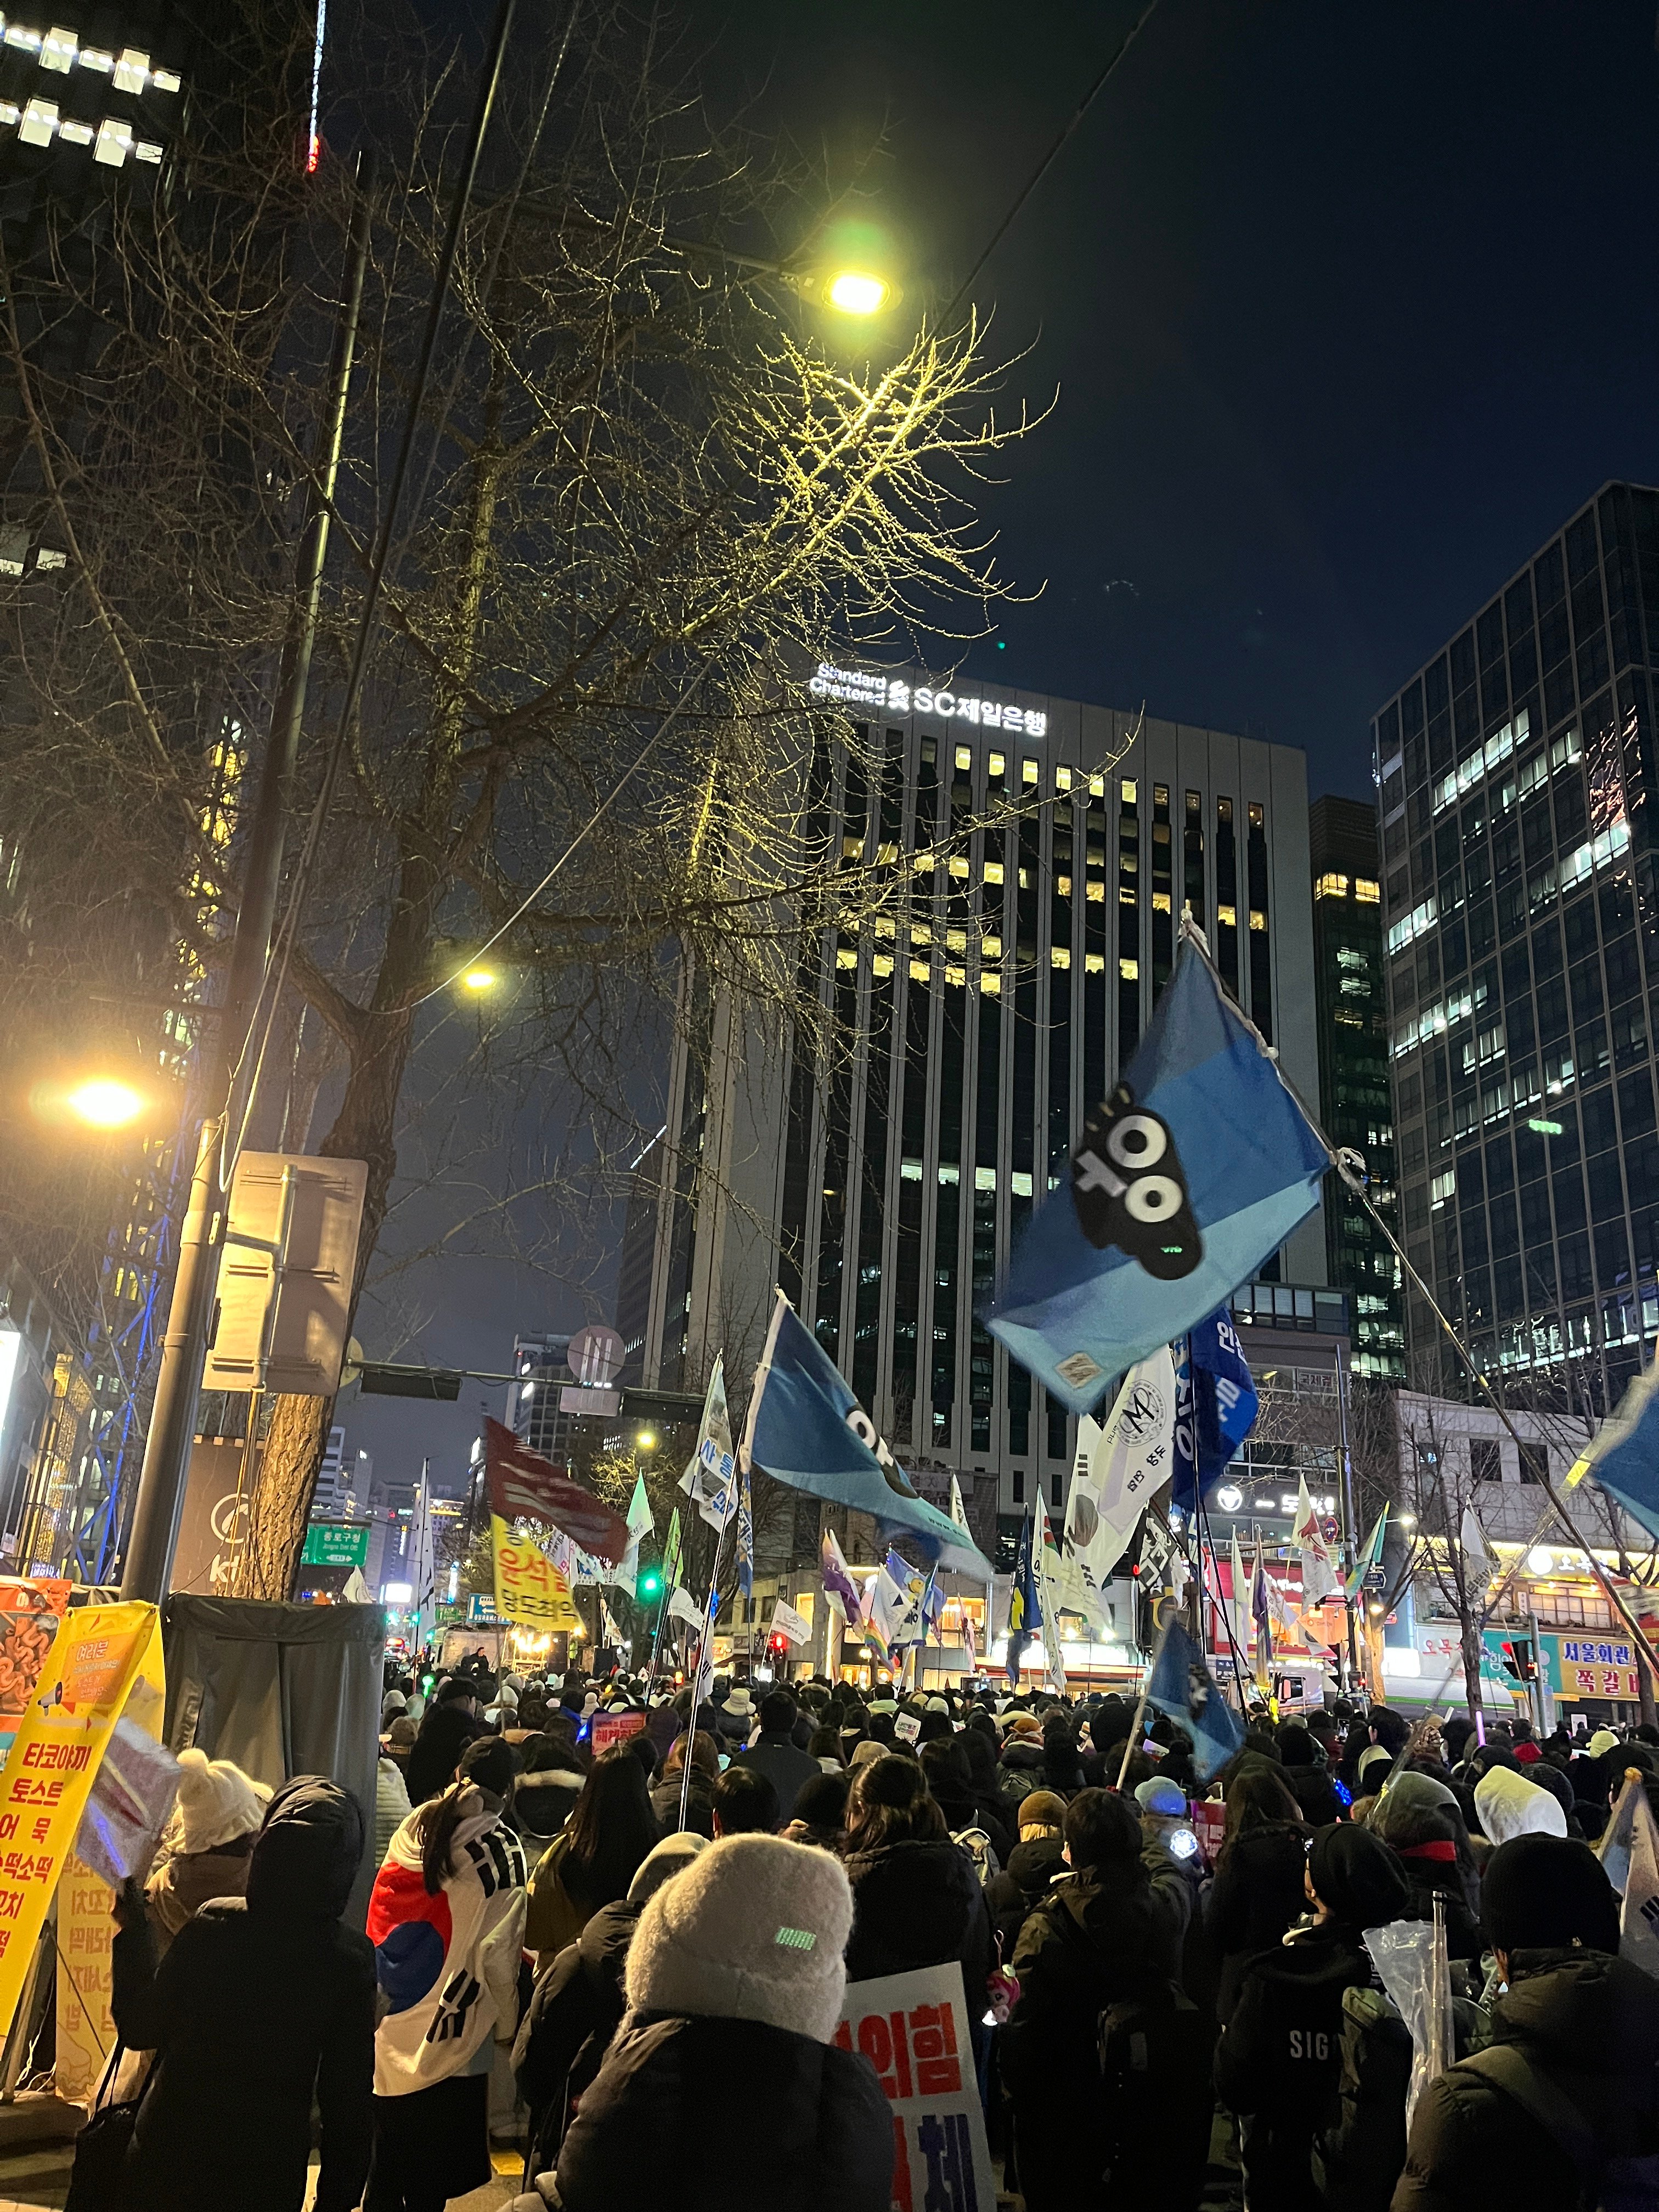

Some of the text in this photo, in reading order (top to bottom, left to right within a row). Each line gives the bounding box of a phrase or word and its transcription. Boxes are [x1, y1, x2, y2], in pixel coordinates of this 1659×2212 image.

[817, 662, 886, 690] Standard
[809, 676, 885, 706] Chartered
[915, 687, 1047, 737] SC제일은행
[324, 1531, 361, 1543] 종로구청
[210, 1554, 240, 1583] kt
[76, 1640, 109, 1662] 여러분
[1564, 1641, 1632, 1666] 서울회관
[22, 1742, 92, 1772] 타코야끼
[8, 1778, 64, 1807] 토스트
[0, 1849, 54, 1884] 떡소떡
